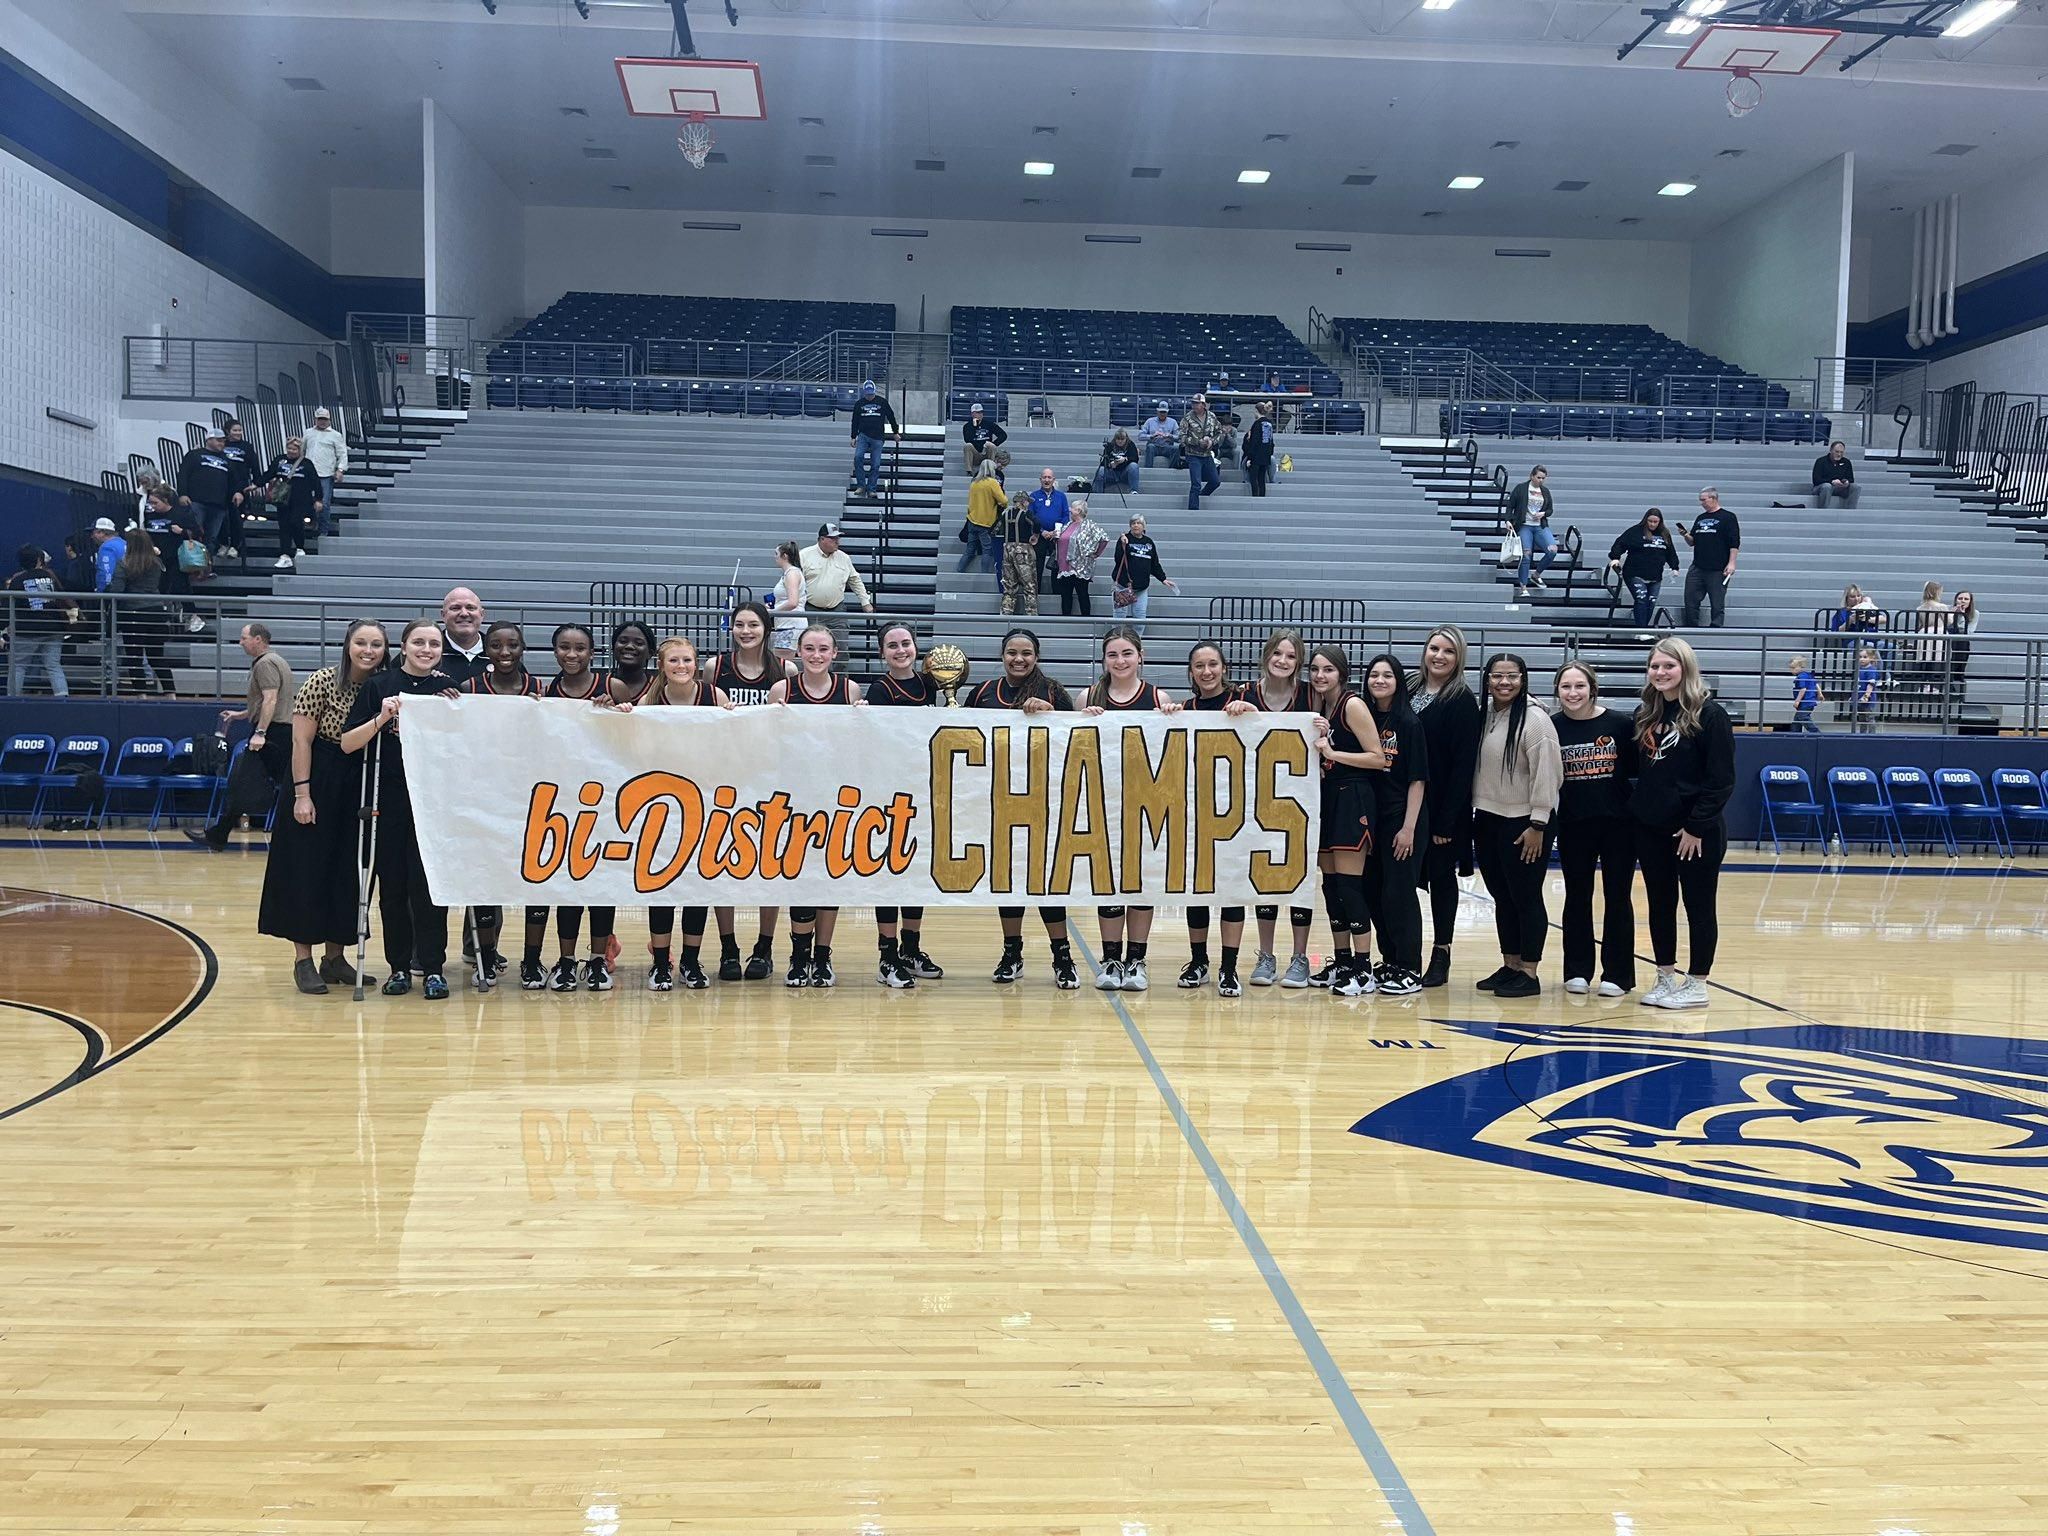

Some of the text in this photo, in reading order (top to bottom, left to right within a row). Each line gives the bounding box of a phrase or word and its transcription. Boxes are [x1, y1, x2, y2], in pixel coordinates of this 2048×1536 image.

[728, 687, 771, 705] BURK
[14, 739, 45, 750] ROOS
[68, 740, 99, 751] ROOS
[133, 743, 164, 753] ROOS
[1560, 745, 1618, 762] ASKETBALL
[1563, 760, 1615, 776] LAYOFFS
[1769, 770, 1799, 780] ROOS
[1837, 771, 1867, 781] ROOS
[1892, 772, 1920, 782] ROOS
[1943, 773, 1971, 783] ROOS
[2002, 773, 2030, 784] ROOS
[520, 725, 1310, 895] bi-District CHAMPS
